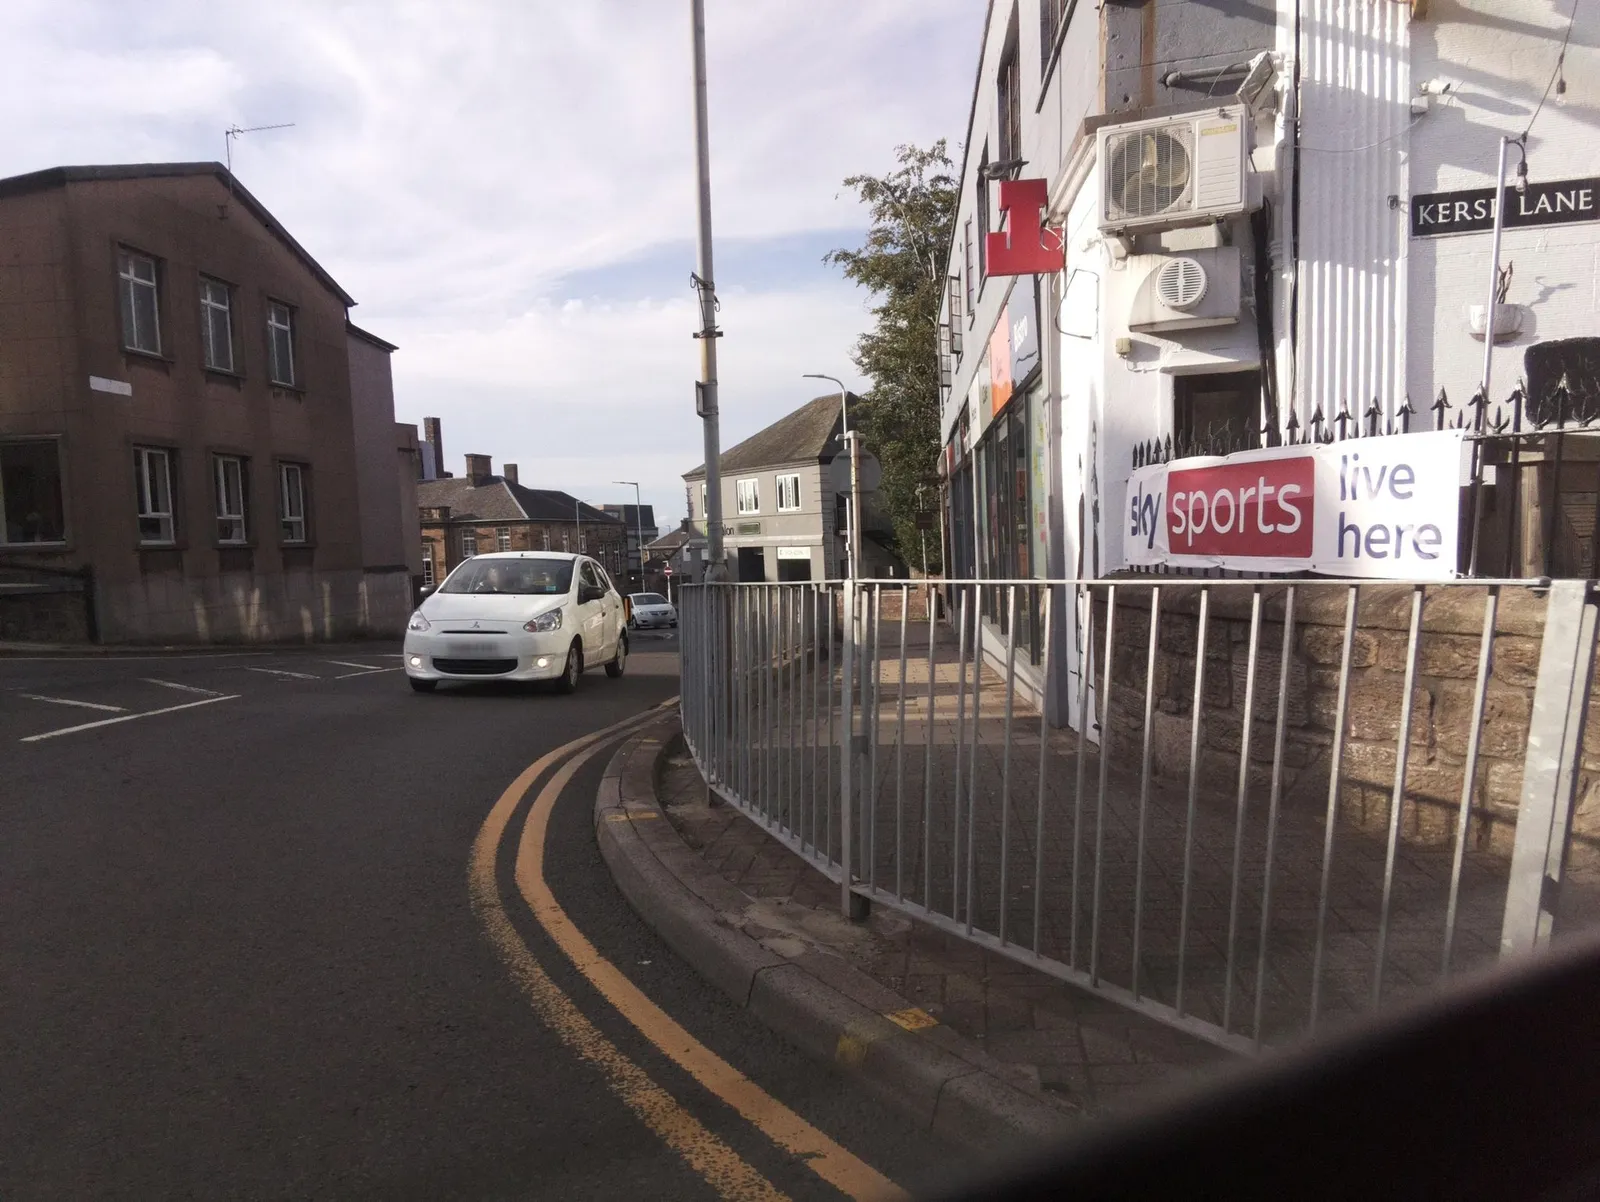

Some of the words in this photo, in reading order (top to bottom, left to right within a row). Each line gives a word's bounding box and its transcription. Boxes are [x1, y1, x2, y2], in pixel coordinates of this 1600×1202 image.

[1519, 189, 1593, 216] LANE
[1340, 453, 1415, 501] live
[1131, 481, 1162, 549] sky
[1172, 476, 1302, 547] sports
[1338, 511, 1442, 560] here
